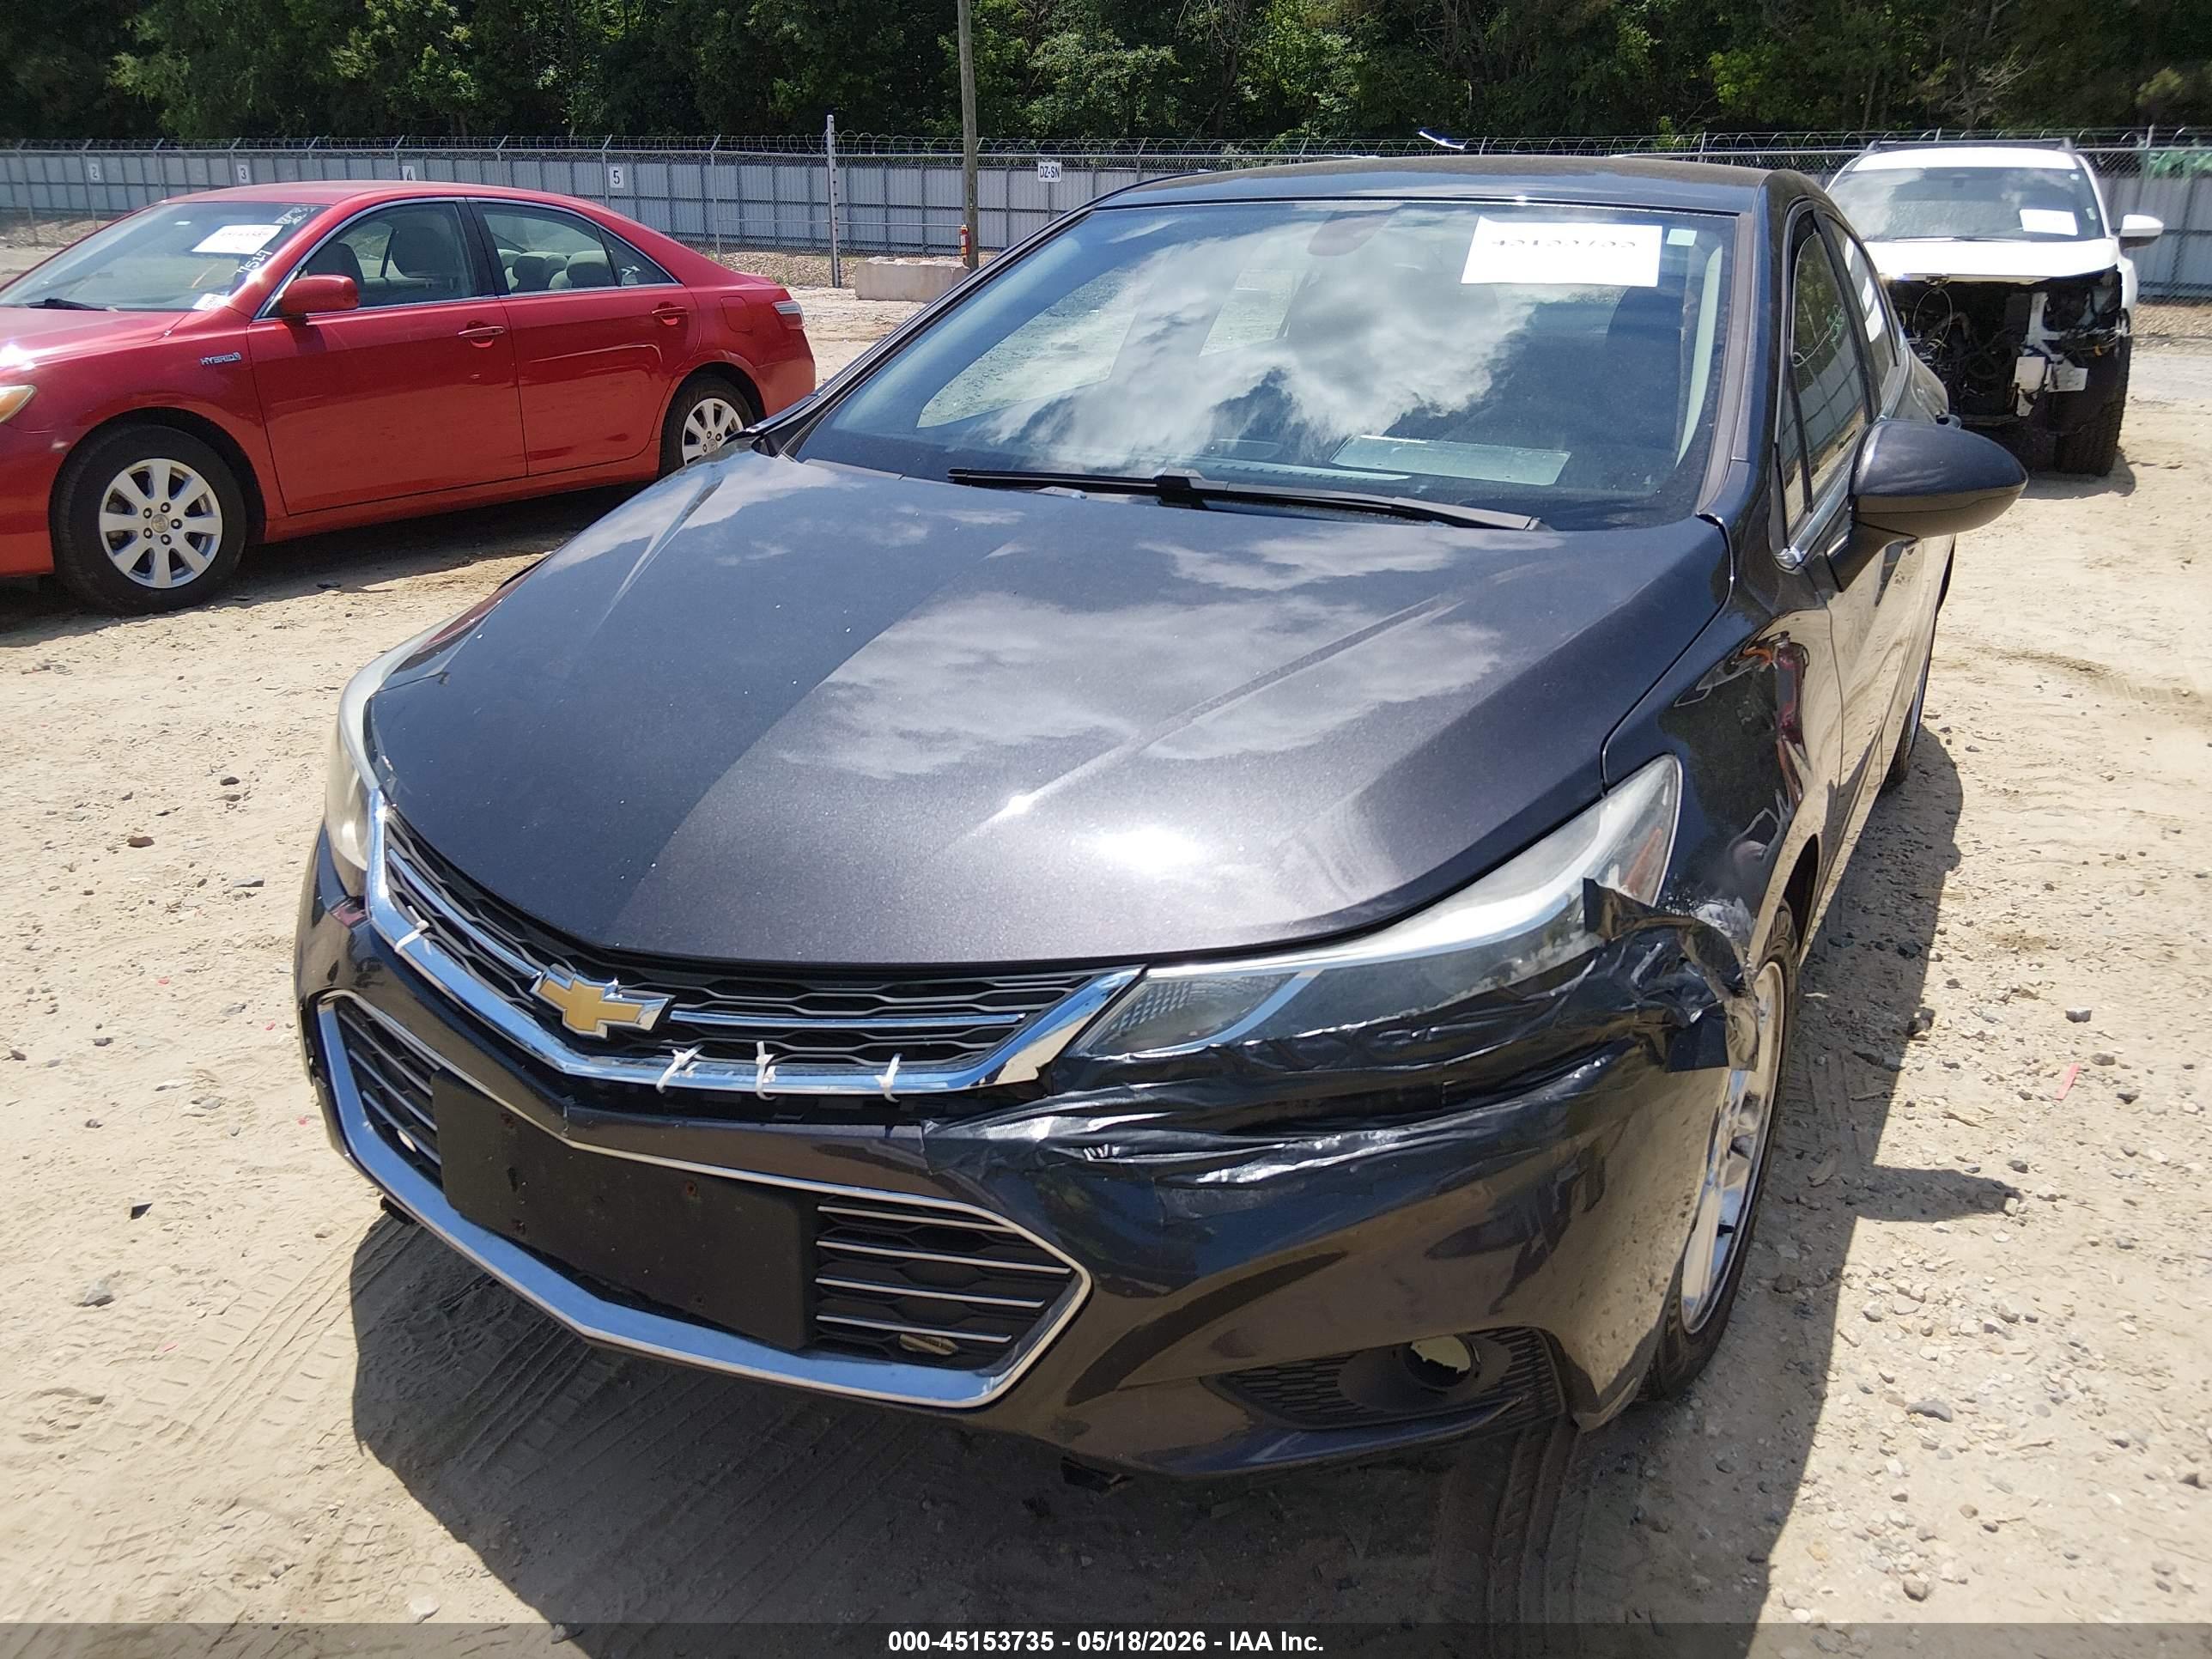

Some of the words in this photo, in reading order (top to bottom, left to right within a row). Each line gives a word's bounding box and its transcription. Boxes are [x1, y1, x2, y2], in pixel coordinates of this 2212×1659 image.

[240, 167, 246, 179] 3
[613, 170, 620, 185] 5
[1039, 166, 1060, 179] DZ-SN
[200, 353, 236, 365] HYBRID
